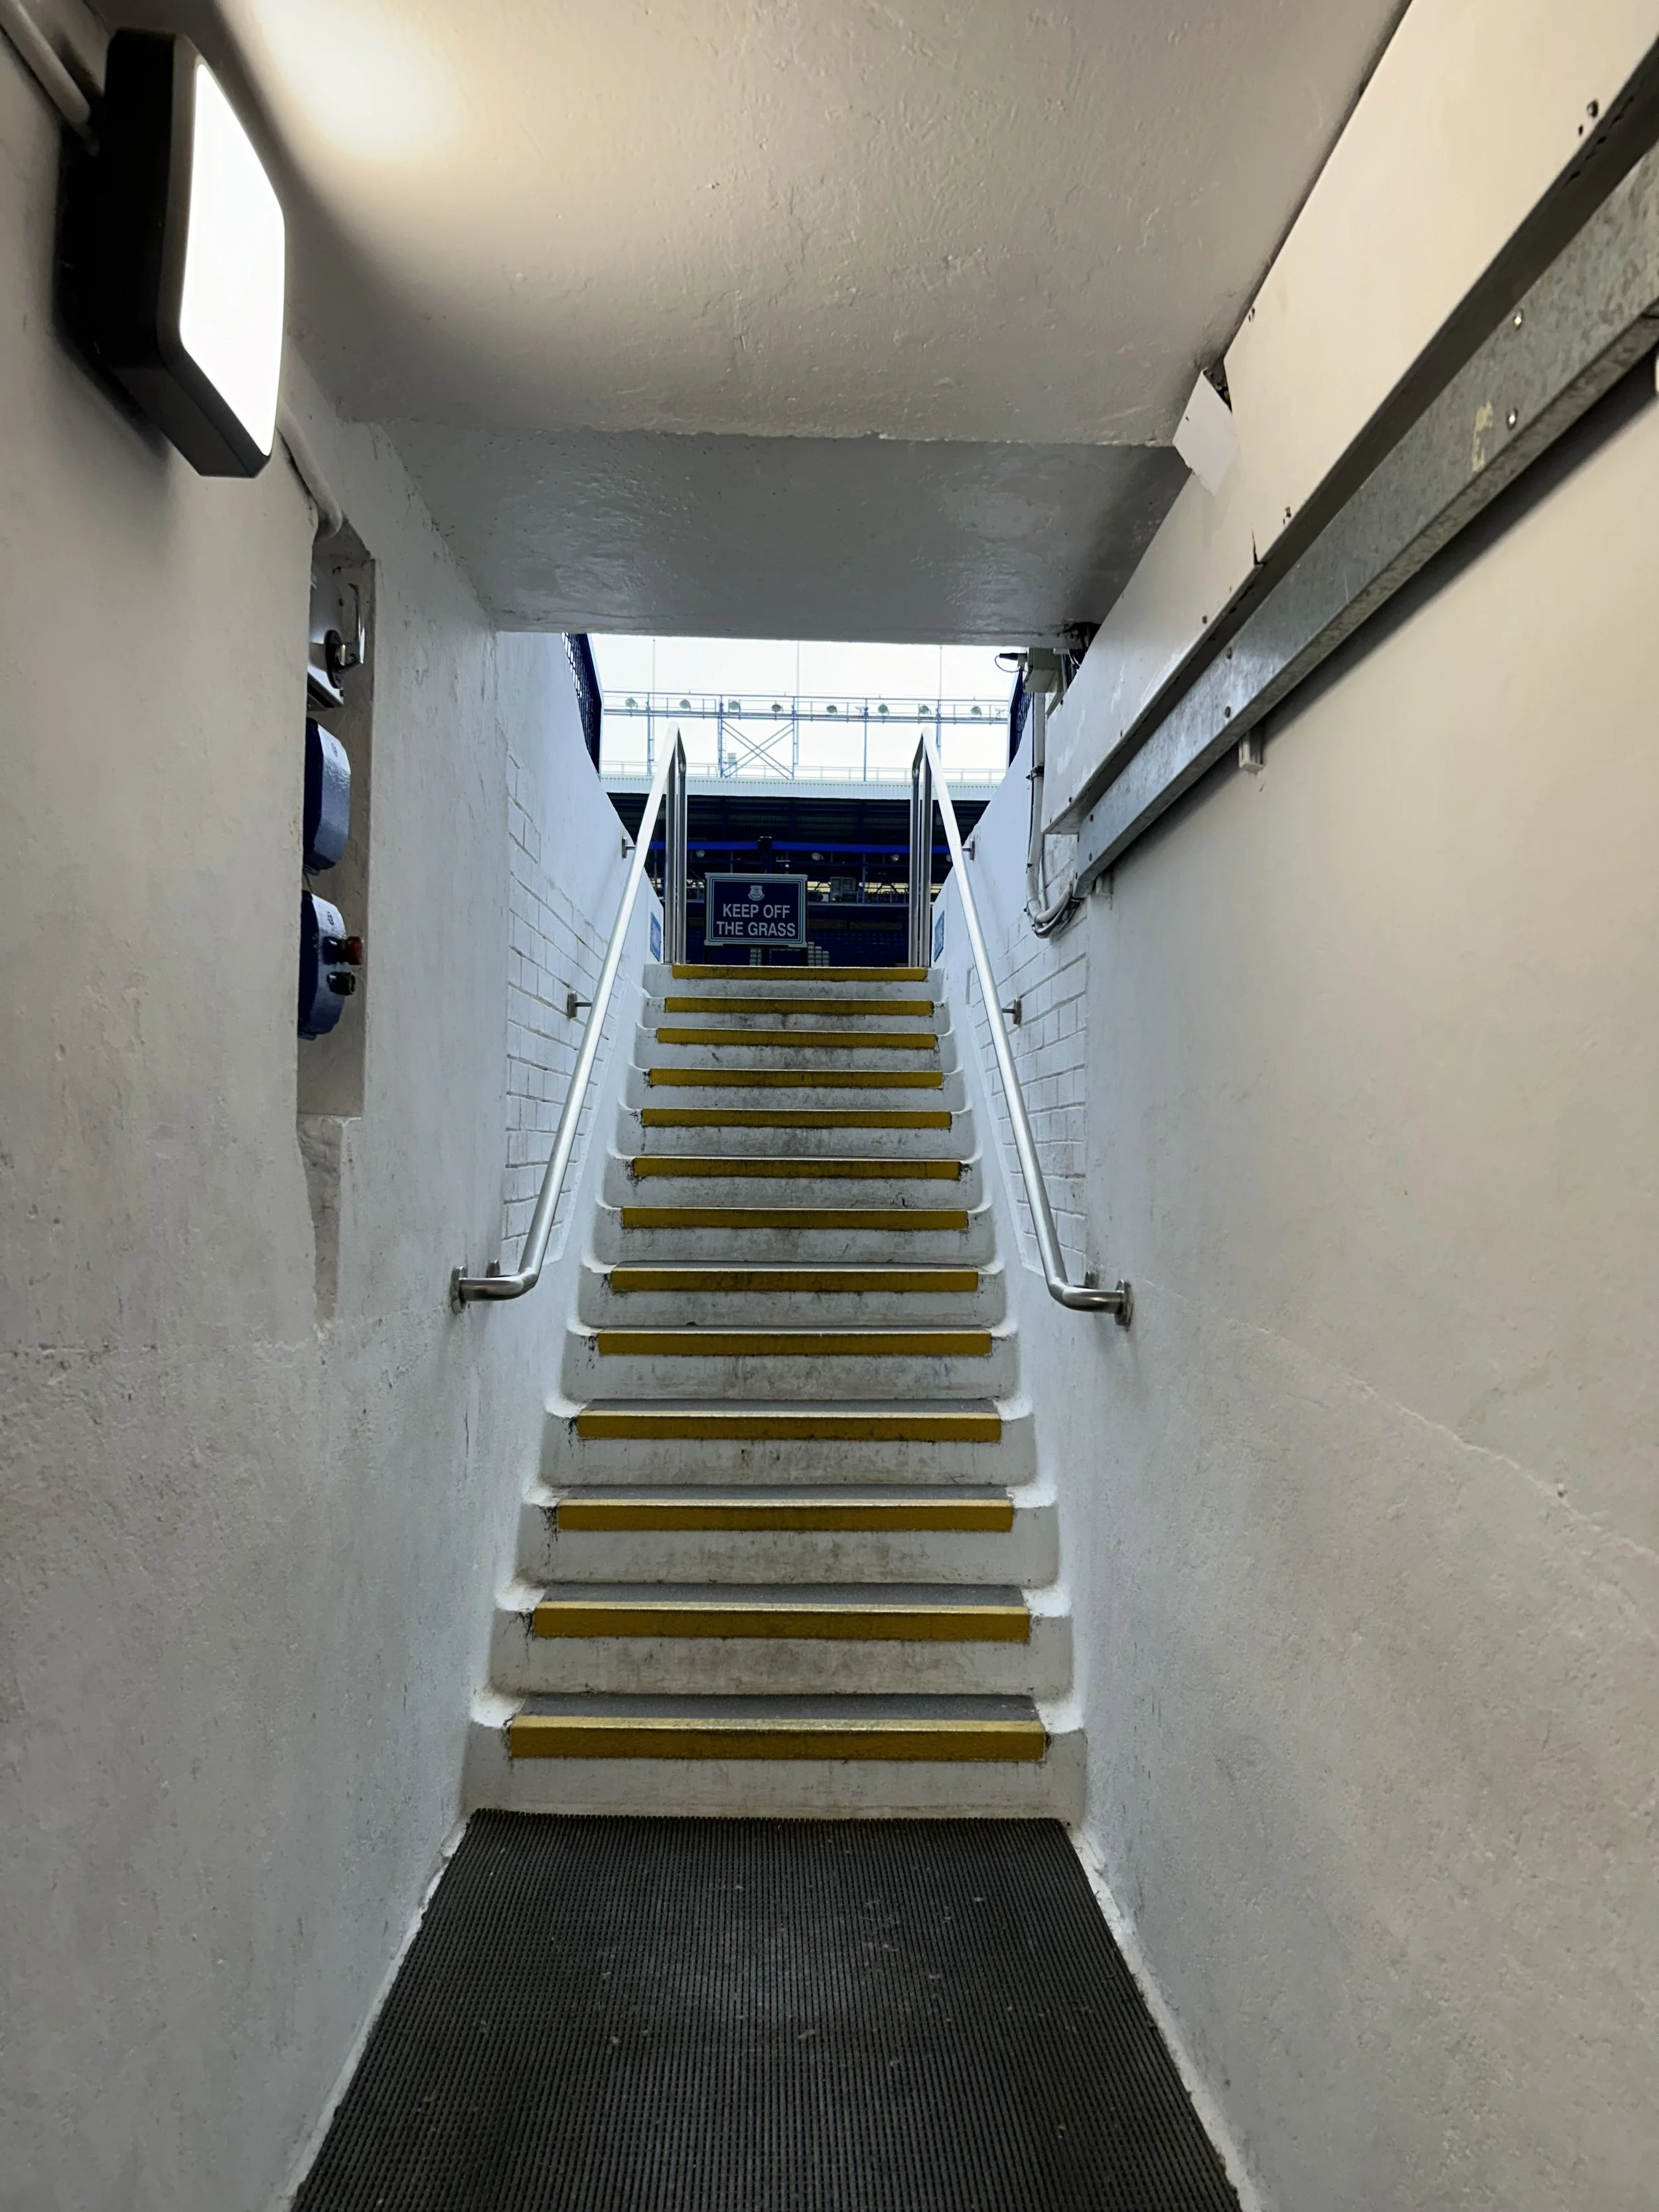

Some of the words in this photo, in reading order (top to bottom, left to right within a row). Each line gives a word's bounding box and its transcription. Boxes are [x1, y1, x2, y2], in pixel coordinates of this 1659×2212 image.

[723, 904, 759, 918] KEEP
[763, 905, 790, 919] OFF
[716, 921, 743, 935] THE
[747, 922, 796, 936] GRASS
